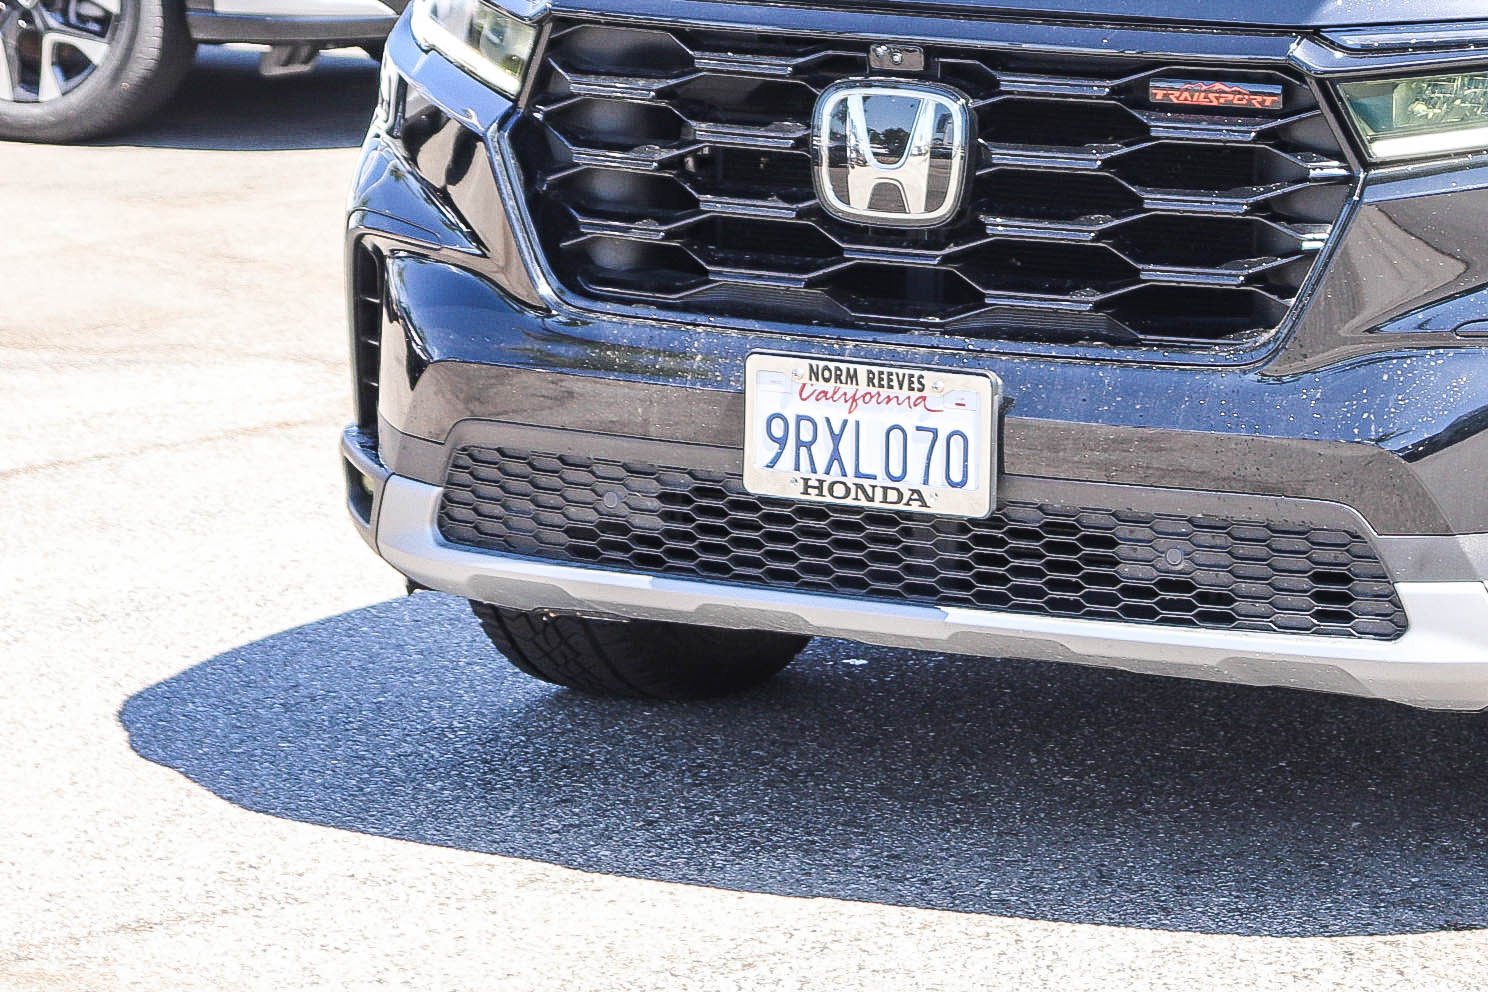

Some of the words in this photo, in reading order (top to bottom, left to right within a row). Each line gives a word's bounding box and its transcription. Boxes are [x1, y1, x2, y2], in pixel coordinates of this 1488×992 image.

[1151, 89, 1280, 108] TRAILSPORT
[808, 363, 859, 386] NORM
[866, 368, 926, 393] REEVES
[798, 382, 944, 415] California
[763, 412, 969, 489] 9RXL070
[799, 476, 931, 508] HONDA
